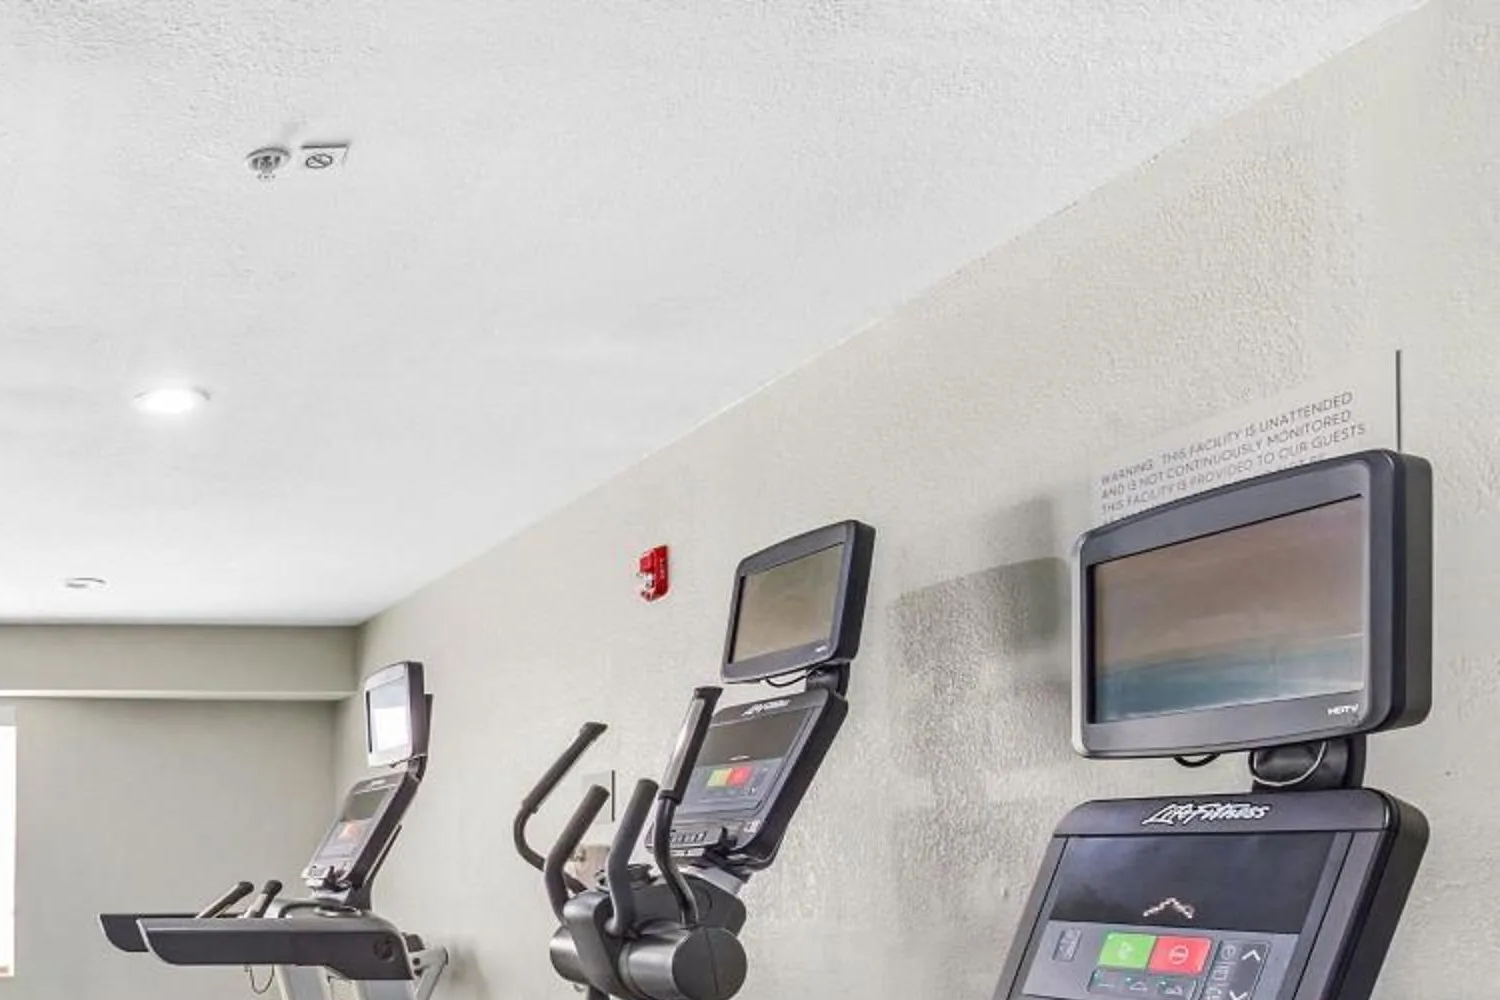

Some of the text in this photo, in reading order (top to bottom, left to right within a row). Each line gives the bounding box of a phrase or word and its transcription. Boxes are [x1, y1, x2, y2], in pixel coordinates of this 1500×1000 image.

[1101, 482, 1125, 499] AND
[1140, 470, 1164, 487] NOT
[1165, 439, 1264, 480] CONTINUOUSLY
[1267, 408, 1353, 447] MONITORED
[1102, 498, 1125, 514] THIS
[1127, 482, 1175, 506] FACILITY
[1189, 458, 1255, 489] PROVIDED
[1257, 450, 1276, 466] TO
[1279, 440, 1308, 460] OUR
[1310, 422, 1367, 450] GUESTS
[1161, 447, 1187, 464] THIS
[1189, 430, 1240, 458] FACILITY
[1244, 422, 1257, 438] IS
[1259, 390, 1354, 433] UNATTENDED
